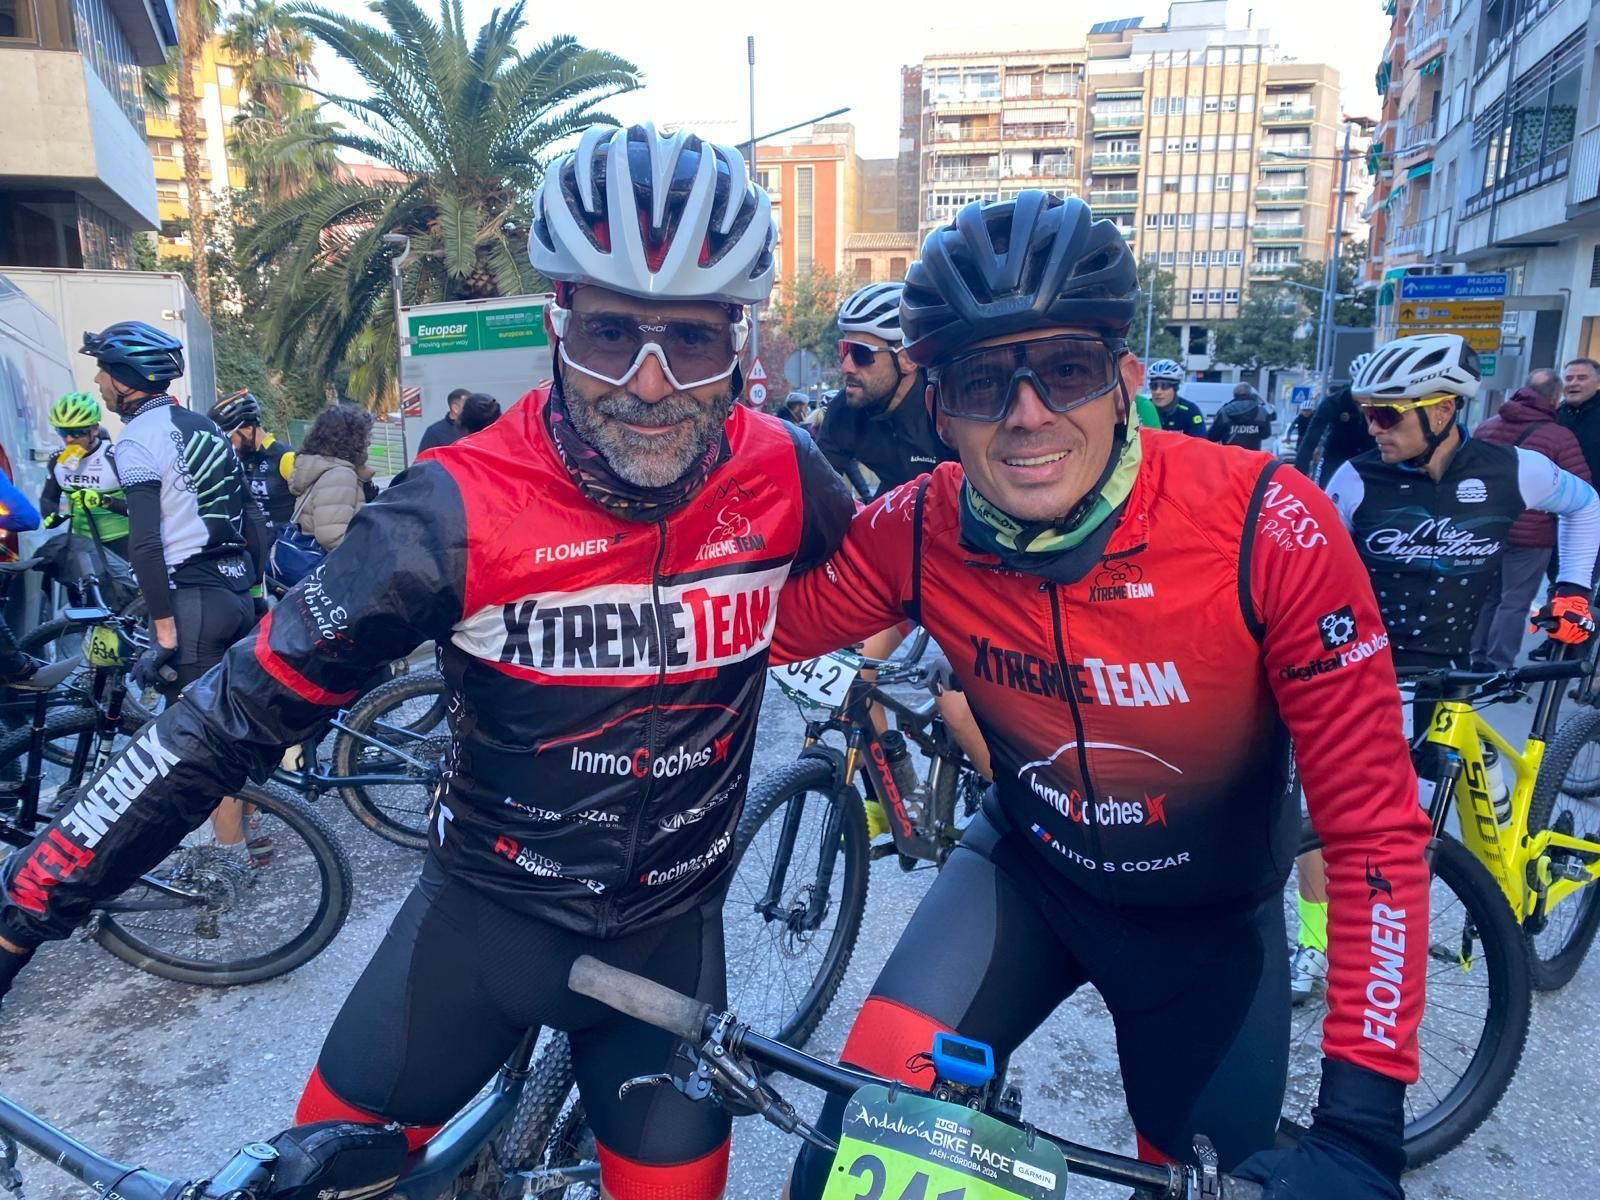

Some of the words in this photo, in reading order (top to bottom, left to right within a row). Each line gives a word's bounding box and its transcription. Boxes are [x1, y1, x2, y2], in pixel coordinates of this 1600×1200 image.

[1466, 276, 1505, 286] MADRID
[1455, 287, 1504, 295] GRANADA
[418, 323, 468, 338] Europcar
[419, 340, 440, 348] moving
[1410, 366, 1453, 386] SCOTT
[754, 389, 763, 398] 10
[64, 474, 100, 485] KERN
[535, 538, 608, 564] FLOWER
[570, 745, 712, 779] InmoCoches
[521, 847, 562, 872] AUTOS
[1363, 903, 1406, 1049] FLOWER
[938, 1118, 956, 1133] UCI
[855, 1105, 935, 1145] Andalucía
[931, 1131, 969, 1156] BIKE
[970, 1143, 1011, 1174] RACE
[982, 1165, 998, 1180] 2024
[1017, 1165, 1052, 1185] GARMIN
